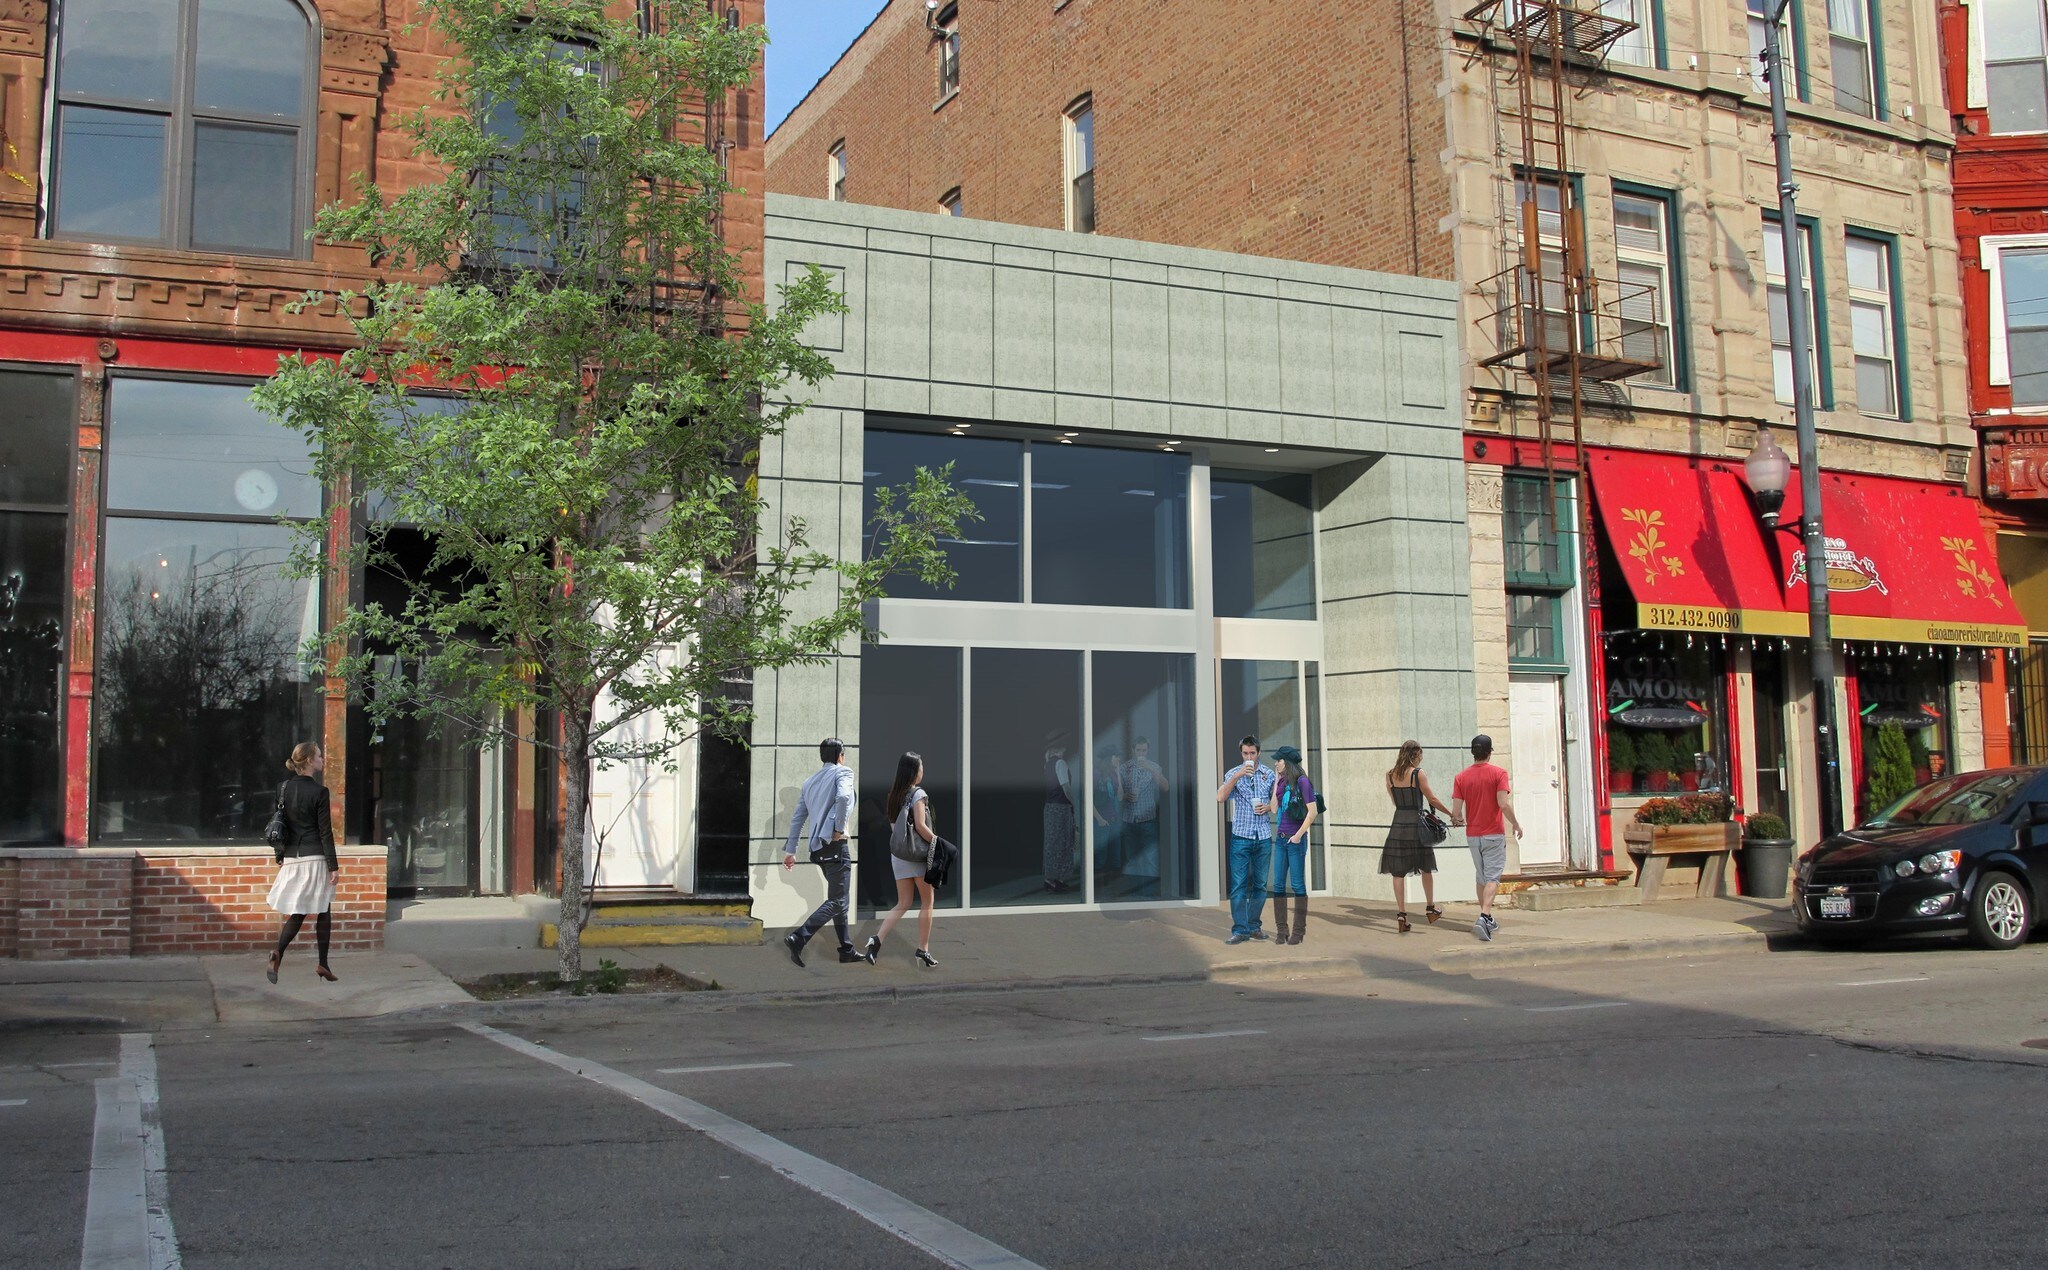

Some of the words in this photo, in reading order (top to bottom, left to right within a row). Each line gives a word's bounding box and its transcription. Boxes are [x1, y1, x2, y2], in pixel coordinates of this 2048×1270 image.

[1823, 537, 1846, 549] IAO
[1823, 549, 1854, 561] MORE
[1827, 574, 1868, 586] torante
[1651, 608, 1739, 629] 312.432.9090
[1927, 623, 2021, 645] ciaoamoreristorante.com
